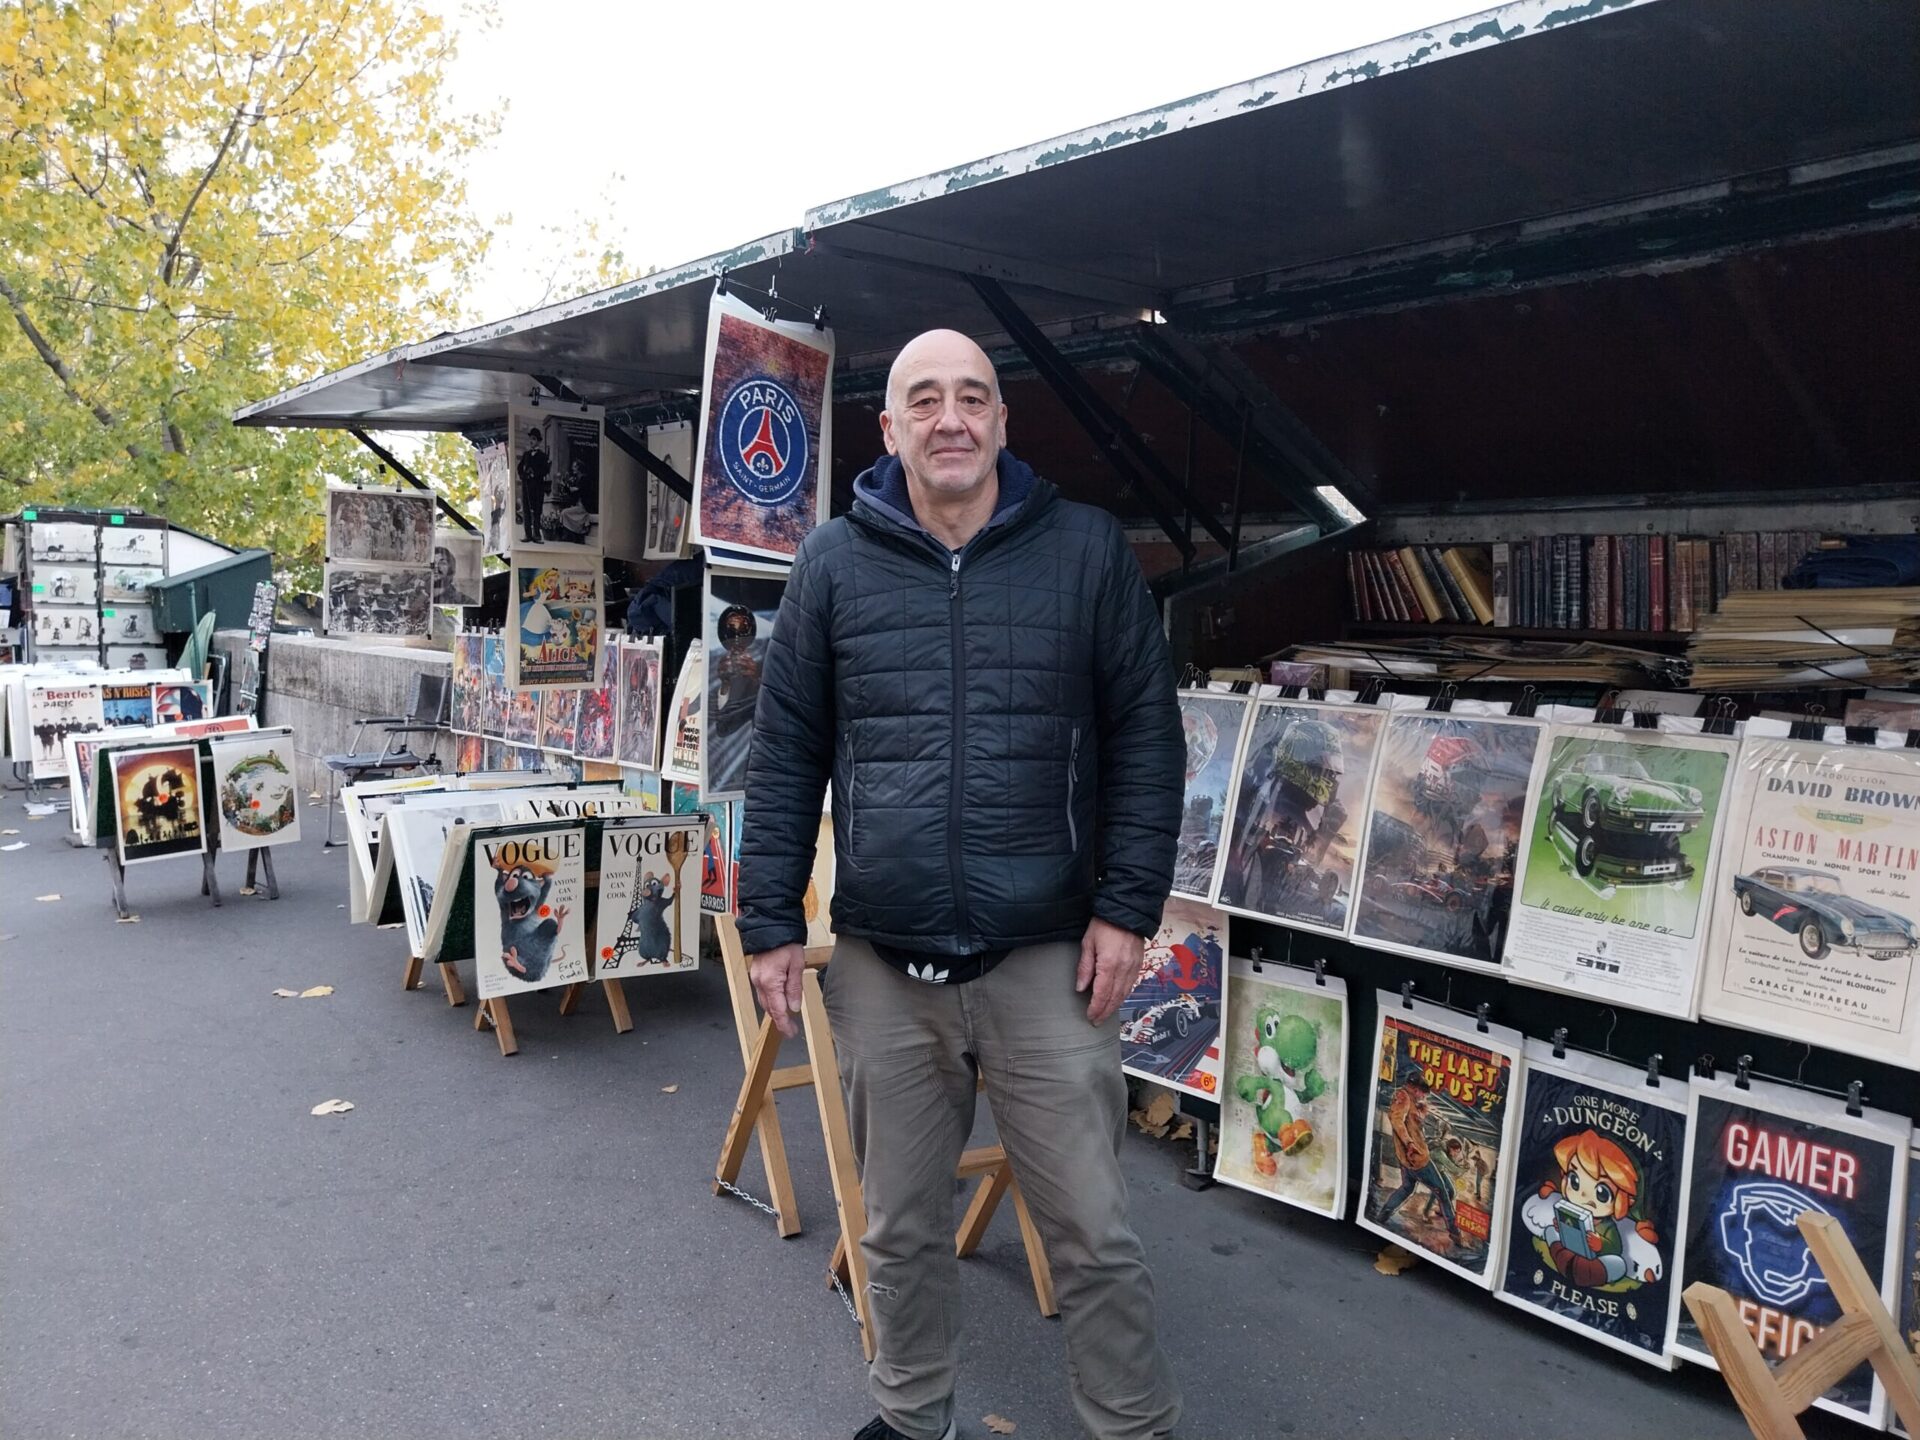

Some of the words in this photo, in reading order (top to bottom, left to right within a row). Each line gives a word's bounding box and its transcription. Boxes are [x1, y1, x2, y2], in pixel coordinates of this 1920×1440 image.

[739, 387, 795, 424] PARIS
[538, 637, 577, 662] ALICE
[43, 700, 74, 708] PARIS
[47, 690, 95, 701] Beatles
[1767, 777, 1832, 798] DAVID
[483, 833, 581, 869] VOGUE
[608, 829, 699, 858] VOGUE
[1754, 826, 1818, 855] ASTON
[1836, 838, 1919, 871] MARTIN
[605, 871, 634, 880] ANYONE
[1761, 851, 1800, 863] CHAMPION
[1824, 862, 1850, 872] MONDE
[1858, 867, 1881, 877] SPORT
[1889, 872, 1906, 880] 1959
[554, 878, 577, 887] ANYONE
[606, 892, 627, 900] COOK
[610, 881, 625, 889] CAN
[701, 895, 725, 911] GARROS
[1540, 898, 1551, 910] It
[1552, 905, 1583, 917] could
[1586, 911, 1608, 925] only
[1611, 915, 1626, 926] be
[1629, 920, 1650, 931] one
[1654, 925, 1673, 935] car
[1749, 976, 1796, 993] GARAGE
[1803, 989, 1868, 1010] MIRABEAU
[1820, 975, 1843, 985] Marcel
[1846, 980, 1887, 994] BLONDEAU
[1409, 1040, 1442, 1068] THE
[1447, 1053, 1497, 1087] LAST
[1424, 1068, 1445, 1090] OF
[1449, 1078, 1474, 1102] US
[1478, 1089, 1503, 1104] PART
[1481, 1101, 1492, 1112] 2
[1574, 1095, 1599, 1108] ONE
[1603, 1100, 1640, 1124] MORE
[1553, 1107, 1656, 1152] DUNGEON
[1727, 1124, 1856, 1198] GAMER
[1457, 1214, 1486, 1234] TENSION
[1551, 1280, 1619, 1317] PLEASE
